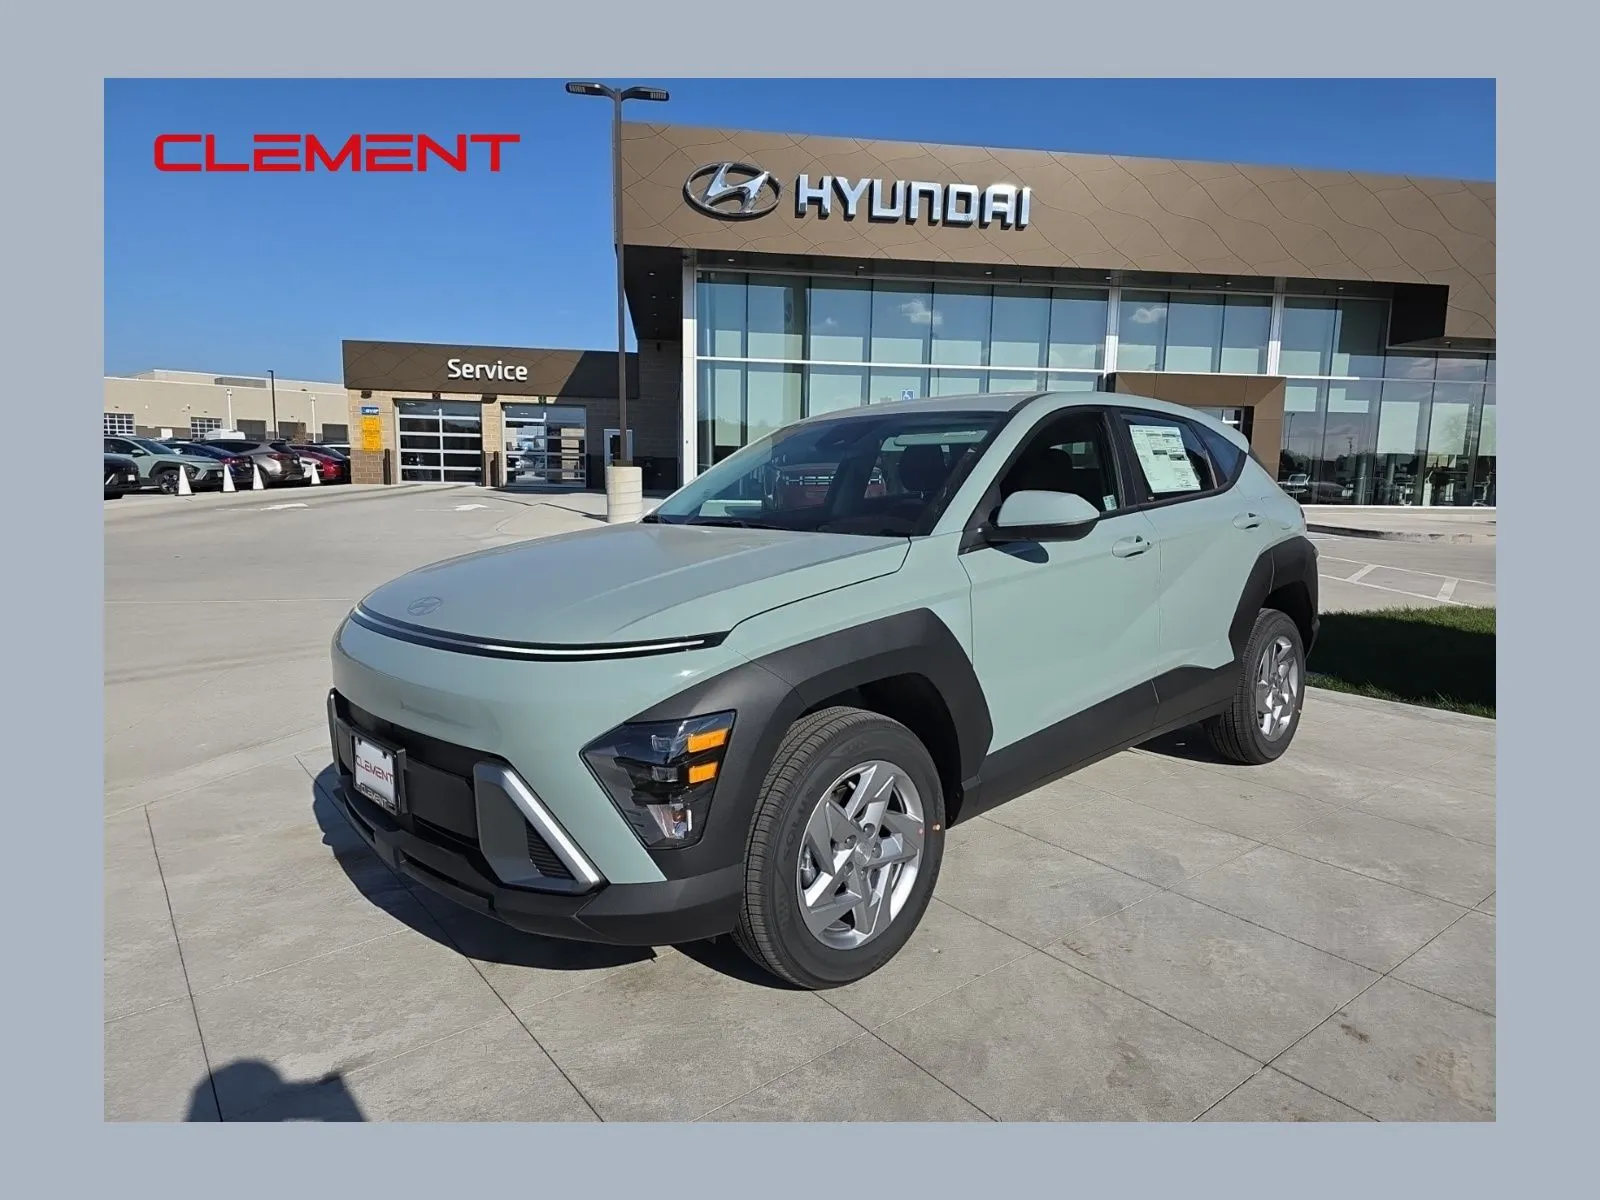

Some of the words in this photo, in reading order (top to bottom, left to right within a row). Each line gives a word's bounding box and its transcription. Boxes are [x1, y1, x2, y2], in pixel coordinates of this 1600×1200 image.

[795, 174, 1033, 230] HYUNDAI
[447, 358, 528, 382] Service
[355, 754, 395, 785] CLEMENT
